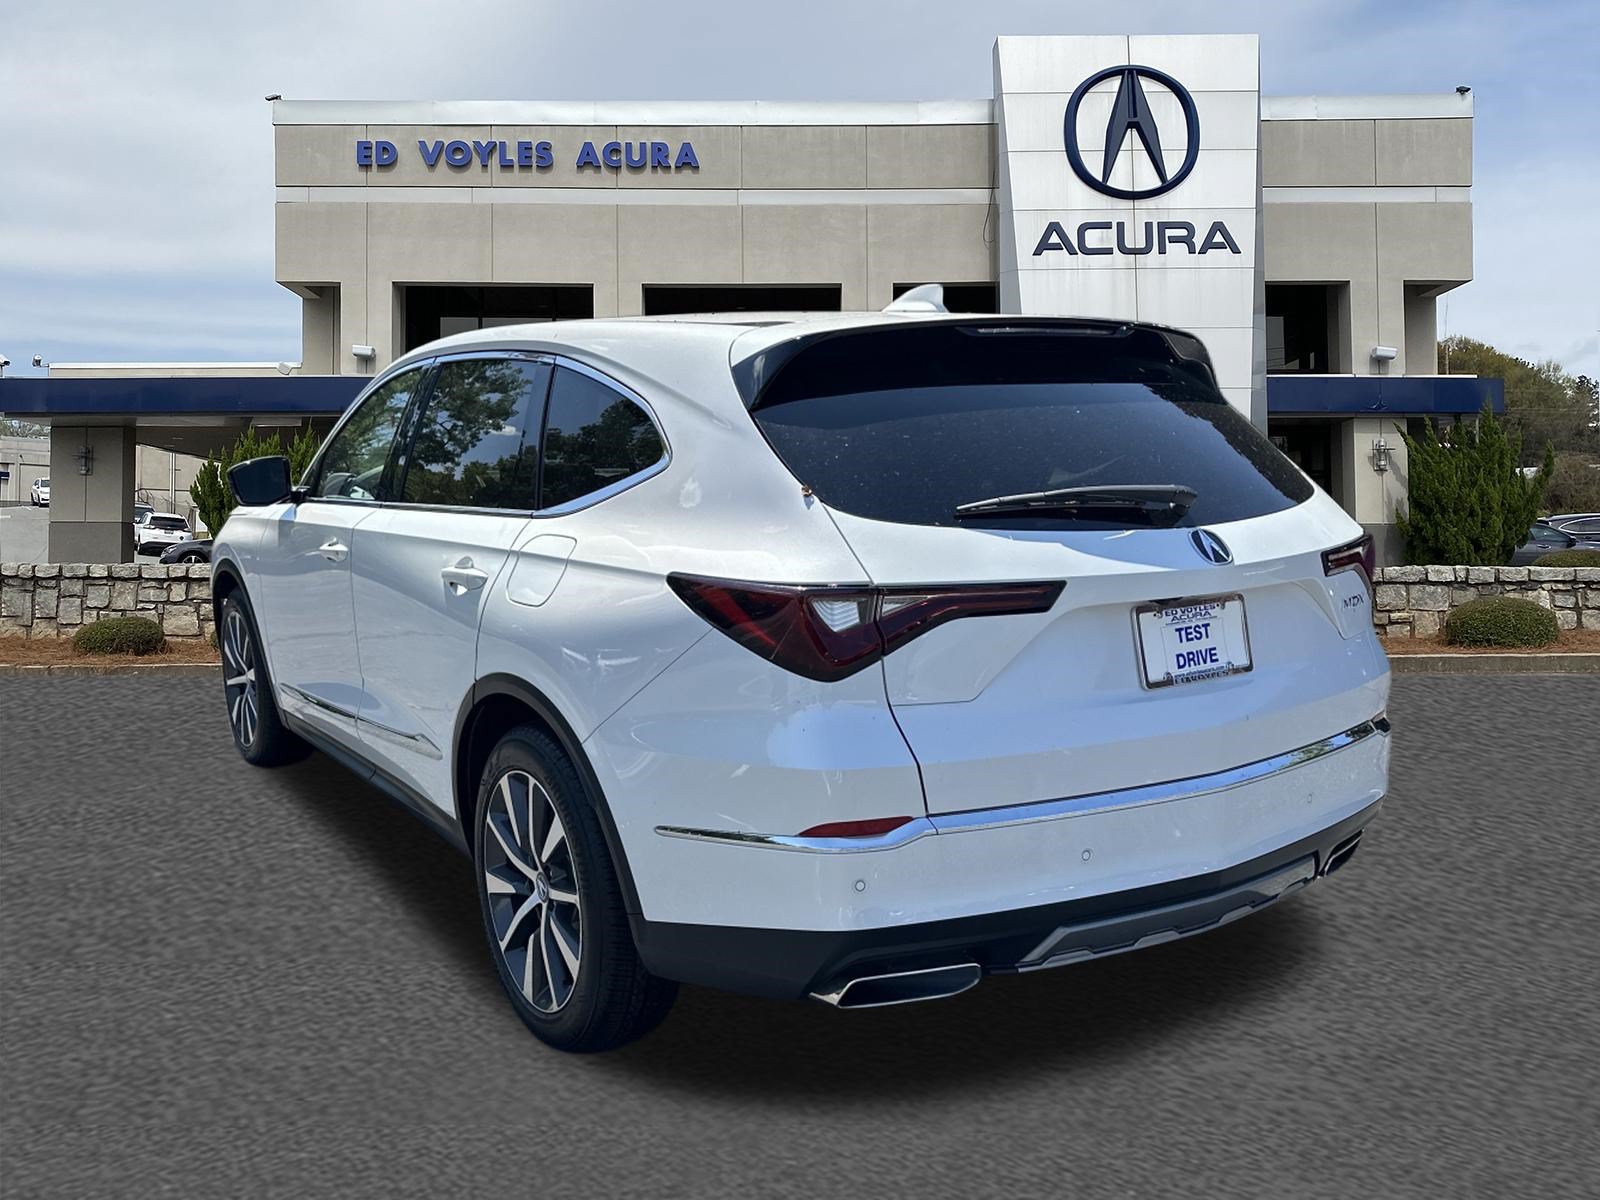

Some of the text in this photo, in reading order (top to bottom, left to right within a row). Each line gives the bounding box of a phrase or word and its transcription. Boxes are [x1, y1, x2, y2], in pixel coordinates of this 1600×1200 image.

[356, 139, 701, 169] ED VOYLES ACURA
[1032, 221, 1242, 256] ACURA
[1343, 593, 1365, 609] MDX
[1171, 610, 1212, 622] ACURA
[1175, 623, 1210, 643] TEST
[1176, 647, 1219, 669] DRIVE
